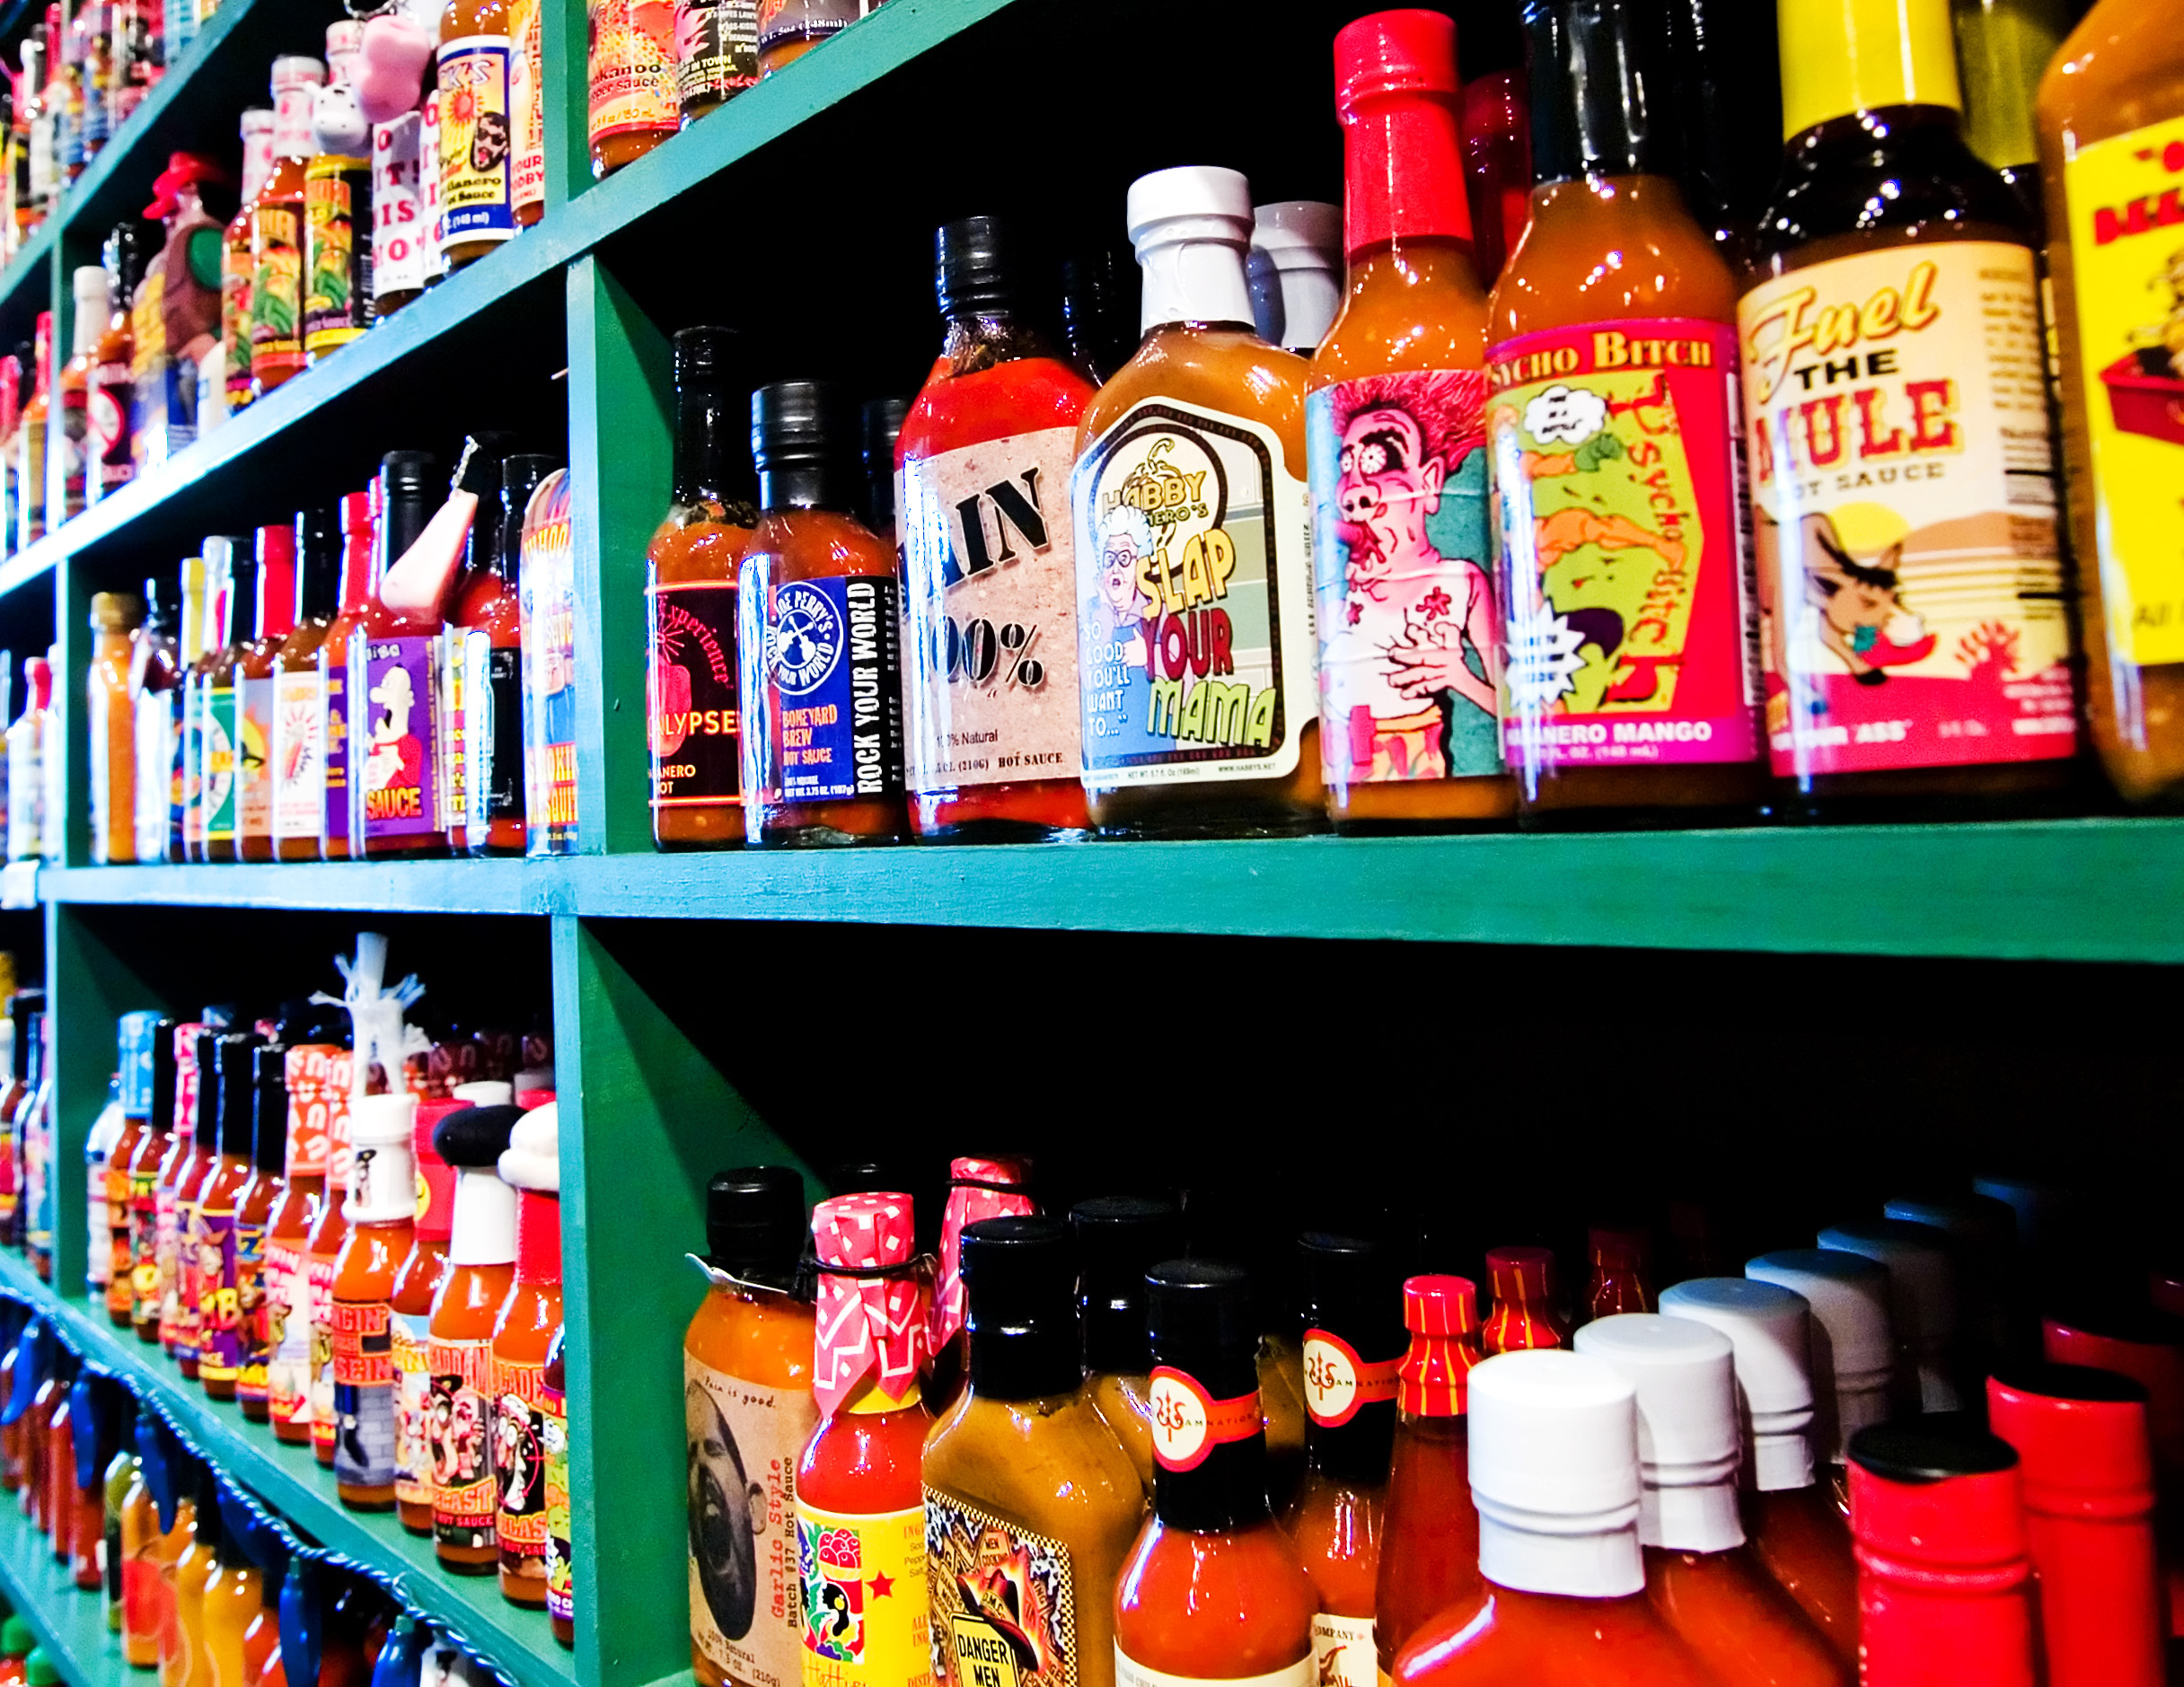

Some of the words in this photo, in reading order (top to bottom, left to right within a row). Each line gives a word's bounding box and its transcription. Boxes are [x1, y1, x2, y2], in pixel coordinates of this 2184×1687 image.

[702, 54, 733, 68] TOWN
[617, 75, 660, 91] sauce
[458, 189, 496, 201] Sauce
[1748, 259, 1940, 404] Fuel
[1793, 347, 1900, 391] THE
[1835, 461, 1947, 491] SAUCE
[1136, 527, 1237, 621] SLAP
[773, 592, 793, 619] JOE
[795, 590, 834, 634] PERRY'S
[846, 582, 878, 660] WORLD
[1085, 639, 1124, 666] GOOD
[1141, 606, 1235, 683] YOUR
[798, 642, 834, 687] WORLD
[1087, 665, 1131, 690] YOU'LL
[851, 667, 881, 727] YOUR
[1087, 689, 1125, 716] WANT
[1146, 674, 1277, 749] MAMA
[782, 703, 838, 728] BONEYARD
[783, 726, 813, 748] BREW
[962, 728, 999, 746] Natural
[1613, 720, 1713, 742] MANGO
[802, 747, 833, 765] SAUCE
[853, 734, 884, 795] ROCK
[999, 751, 1020, 769] HOT
[1025, 751, 1063, 766] SAUCE
[365, 786, 423, 821] SAUCE
[727, 1385, 736, 1397] is
[767, 1458, 783, 1526] Style
[782, 1457, 795, 1505] Sauce
[456, 1515, 494, 1527] SAUCE
[783, 1511, 795, 1538] Hot
[769, 1537, 785, 1620] Garlic
[787, 1583, 797, 1629] Batch
[957, 1633, 1009, 1665] DANGER
[973, 1665, 1000, 1687] MEN
